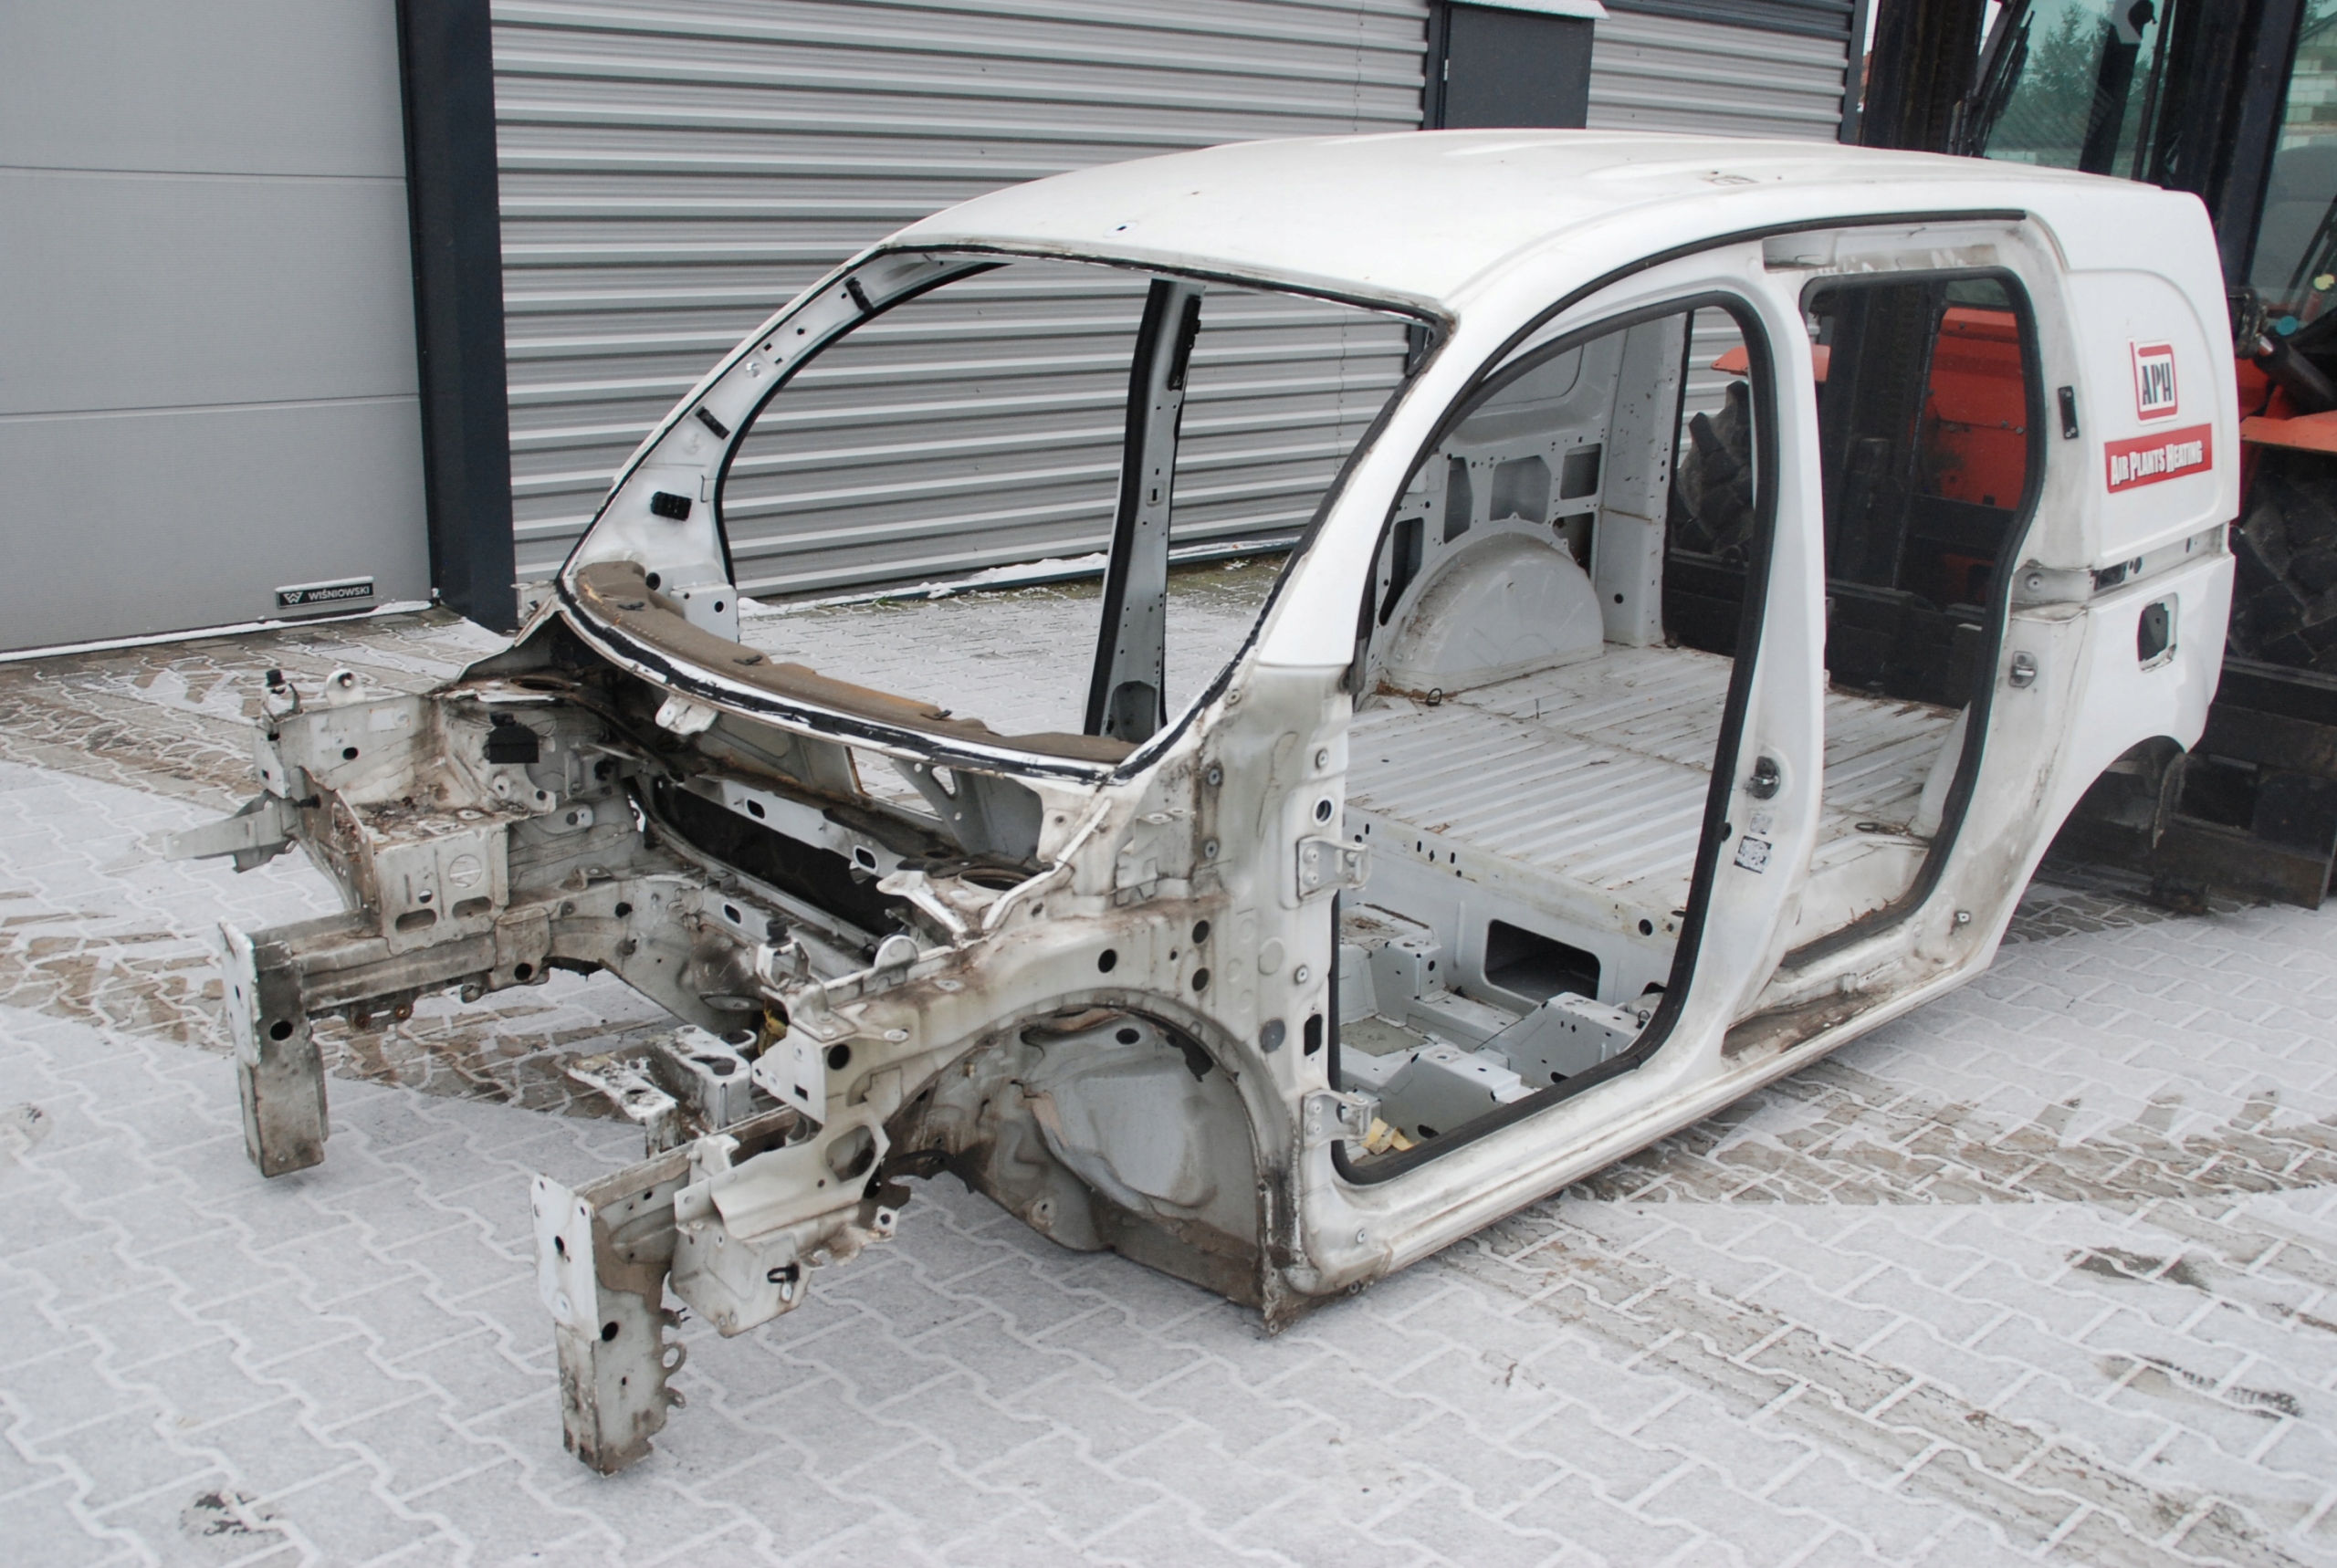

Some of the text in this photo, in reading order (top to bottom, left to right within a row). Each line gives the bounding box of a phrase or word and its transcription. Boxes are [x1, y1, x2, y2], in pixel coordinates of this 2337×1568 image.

[2142, 361, 2173, 405] APH
[2111, 440, 2204, 486] AIR PLANTS HEATING
[309, 586, 370, 601] WIŚNIOWSKI
